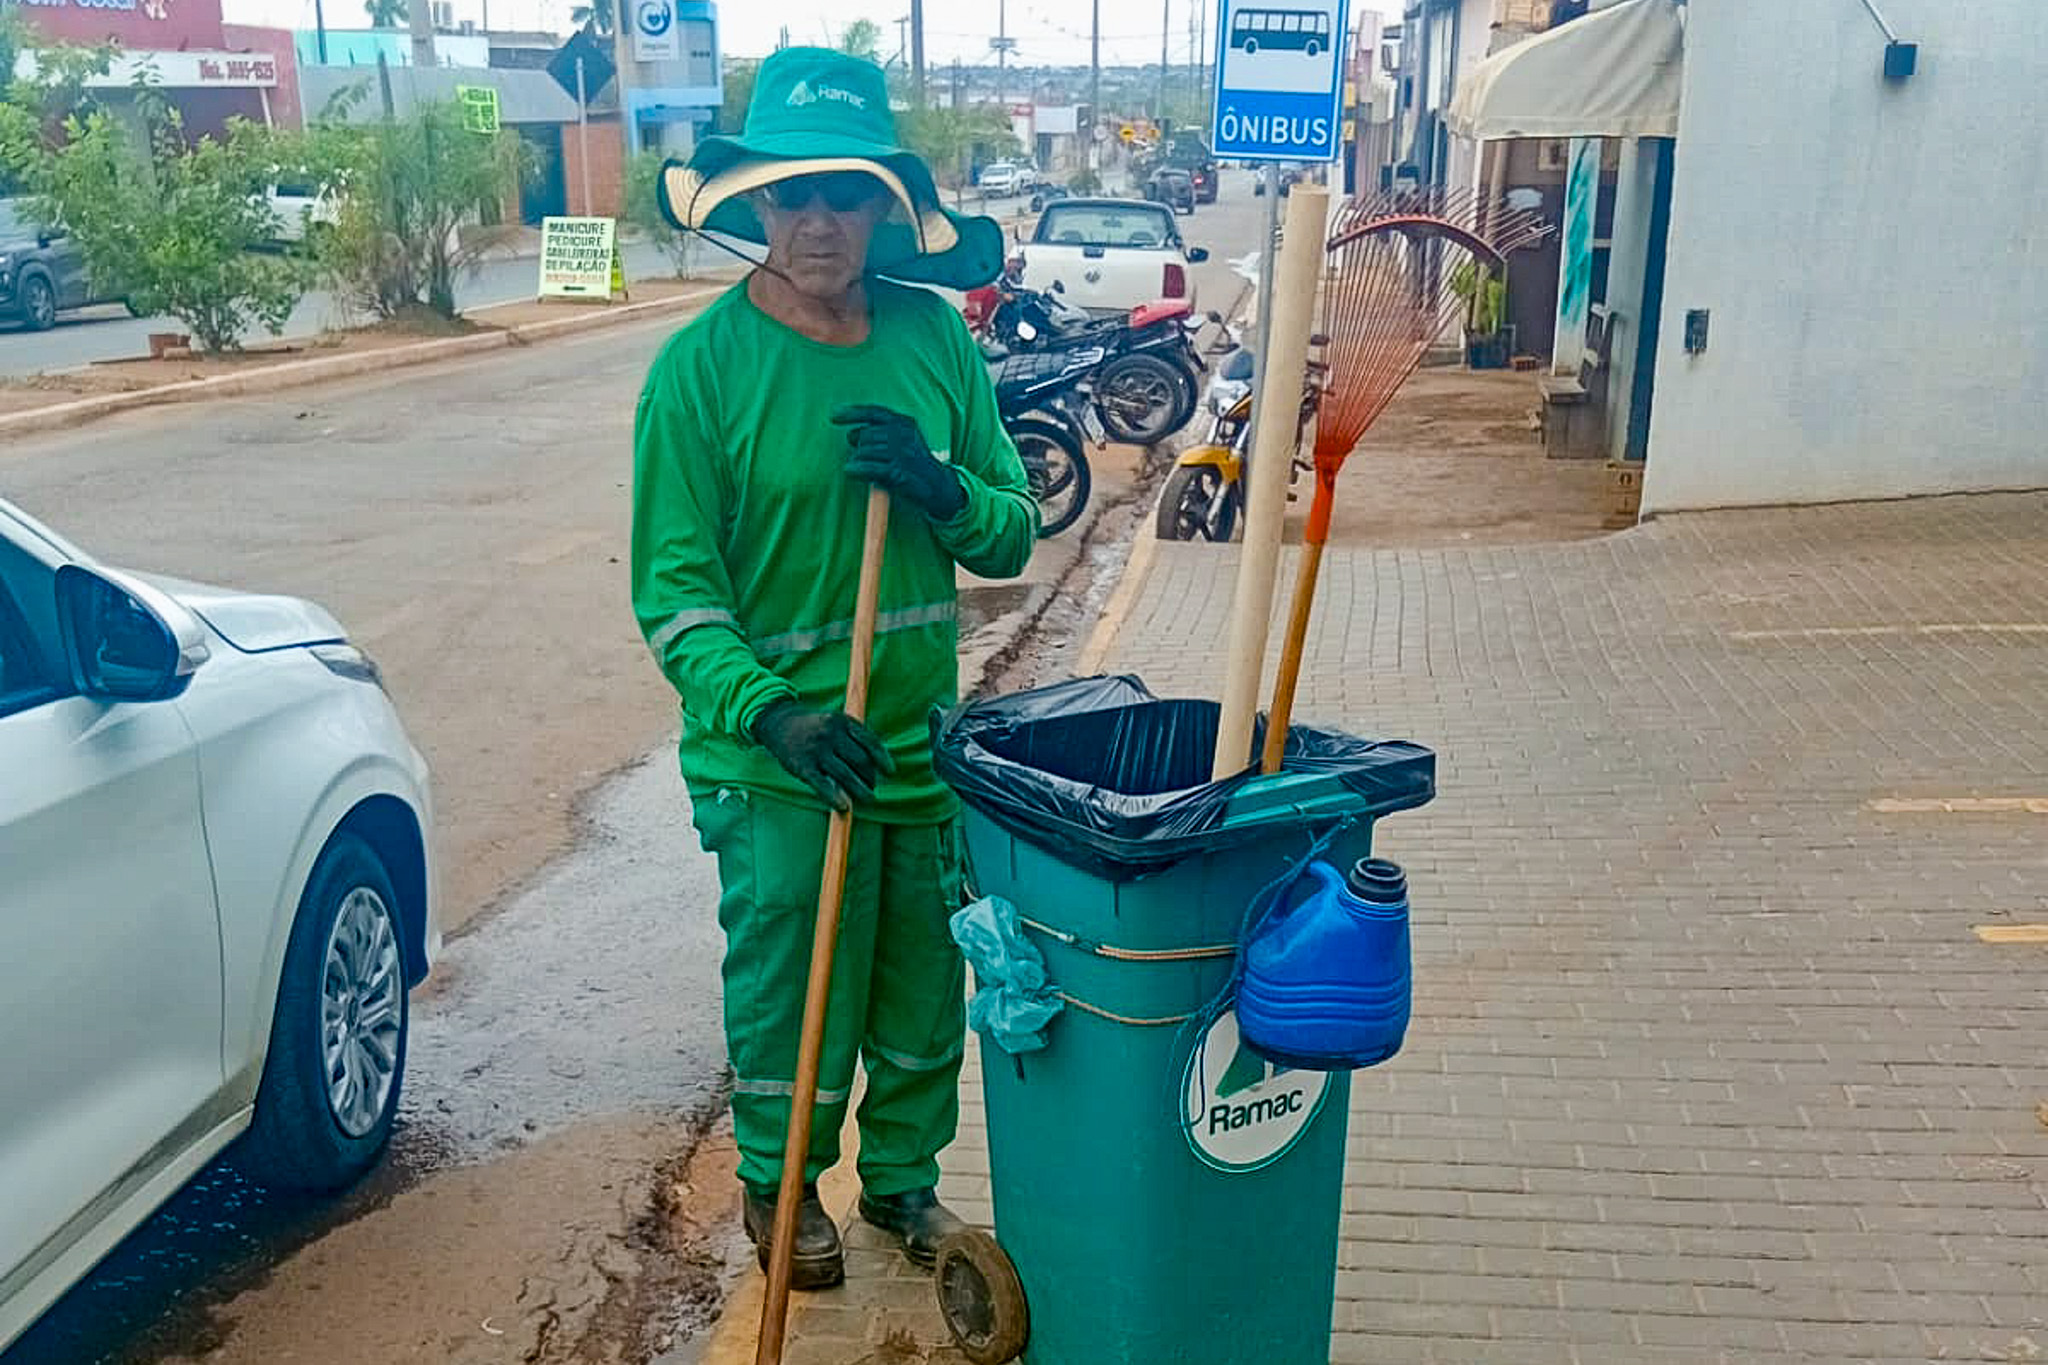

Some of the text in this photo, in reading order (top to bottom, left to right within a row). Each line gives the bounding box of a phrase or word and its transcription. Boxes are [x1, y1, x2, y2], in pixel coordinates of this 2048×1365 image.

[1220, 106, 1328, 146] ÔNIBUS
[548, 222, 606, 235] MANICURE
[547, 235, 602, 247] PEDICURE
[545, 259, 606, 273] DEPILAÇÃO
[1208, 1089, 1304, 1136] Ramac
